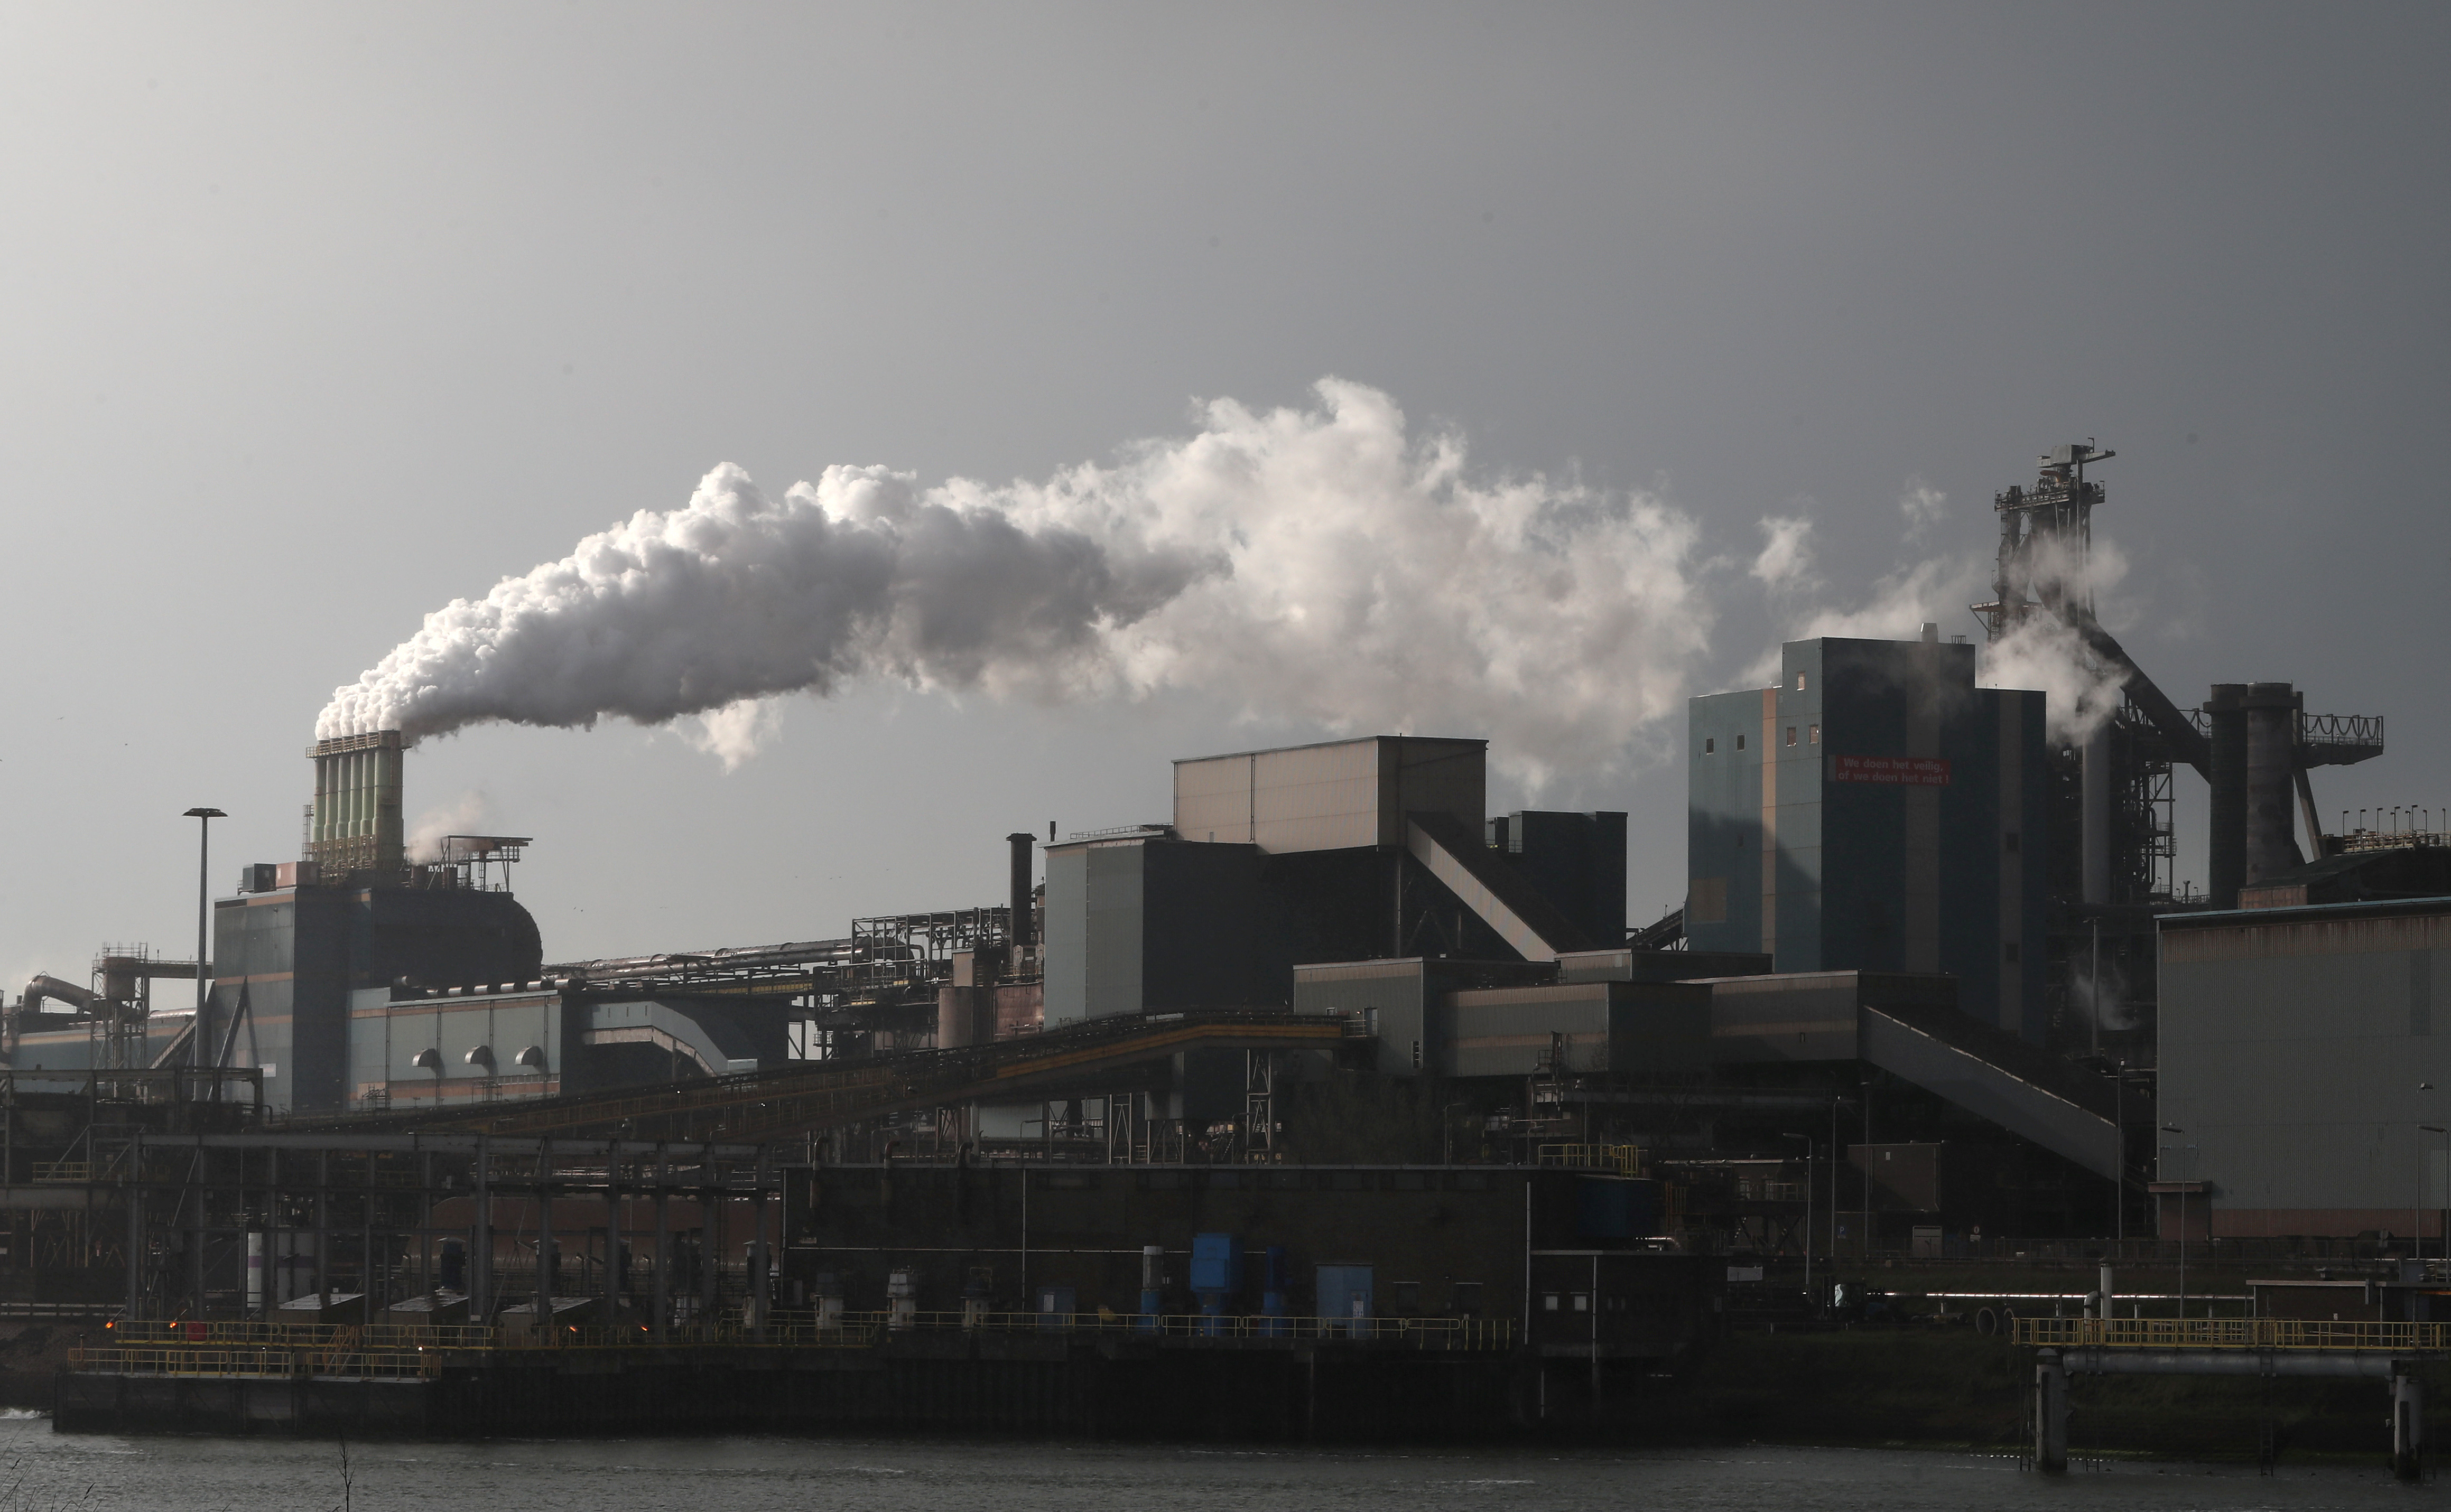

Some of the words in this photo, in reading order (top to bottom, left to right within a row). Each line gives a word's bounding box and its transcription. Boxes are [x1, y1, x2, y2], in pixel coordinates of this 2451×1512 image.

[1844, 758, 1859, 767] We
[1863, 759, 1888, 769] doen
[1893, 760, 1909, 769] het
[1914, 761, 1943, 773] veilig,
[1839, 771, 1849, 780] of
[1872, 772, 1897, 782] doen
[1902, 773, 1918, 782] het
[1922, 774, 1942, 783] niet
